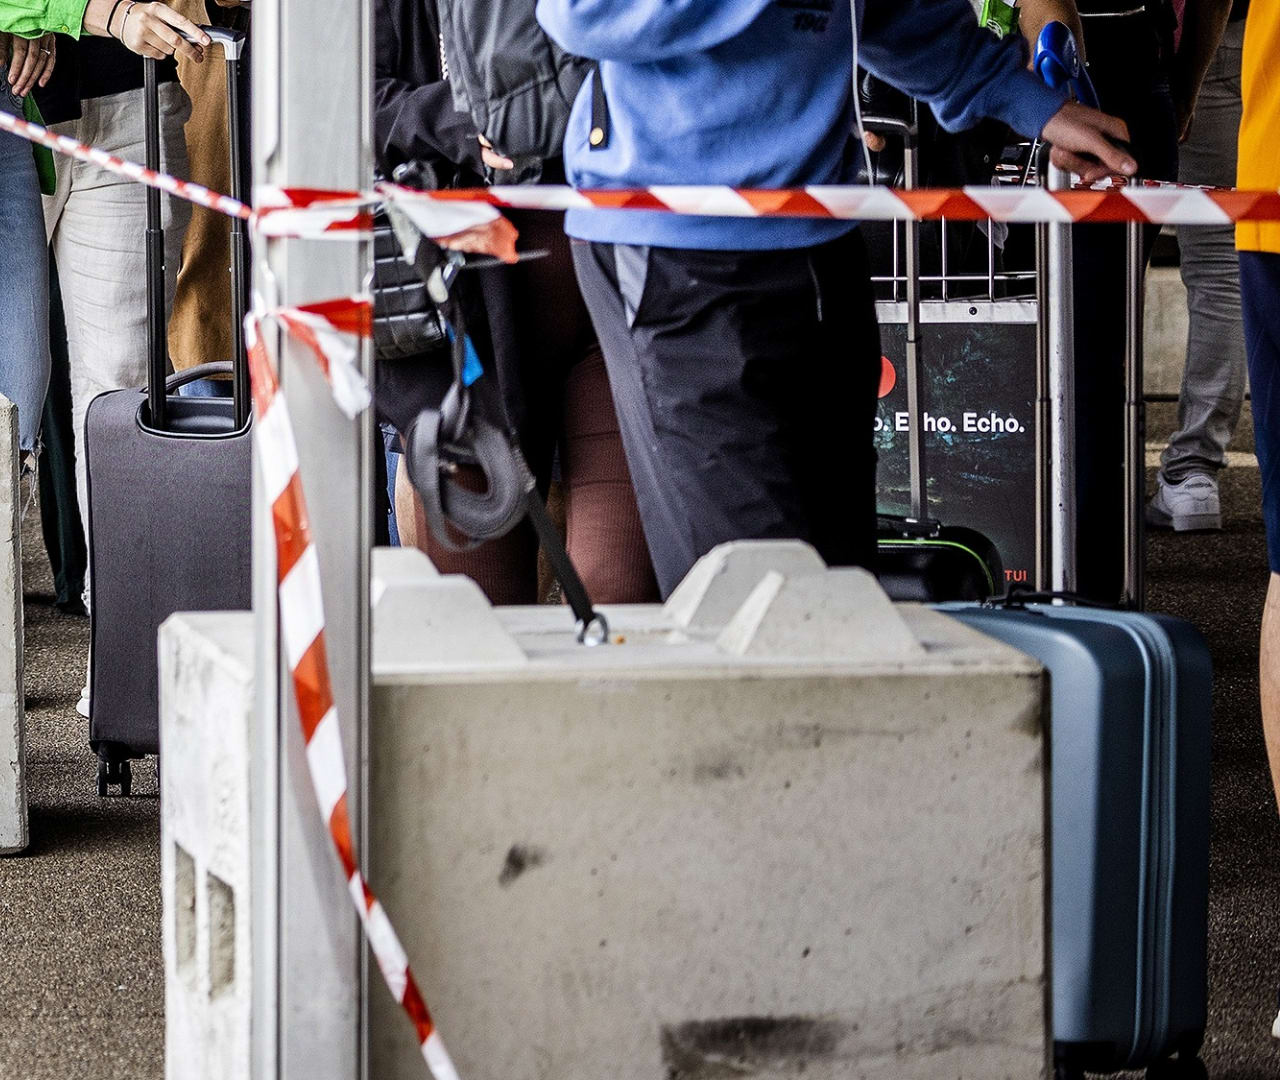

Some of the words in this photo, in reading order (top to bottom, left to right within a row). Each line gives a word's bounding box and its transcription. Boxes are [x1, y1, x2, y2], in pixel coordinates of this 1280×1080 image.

[895, 412, 957, 433] Eho.
[963, 412, 1026, 433] Echo.
[1004, 569, 1028, 582] TUI
